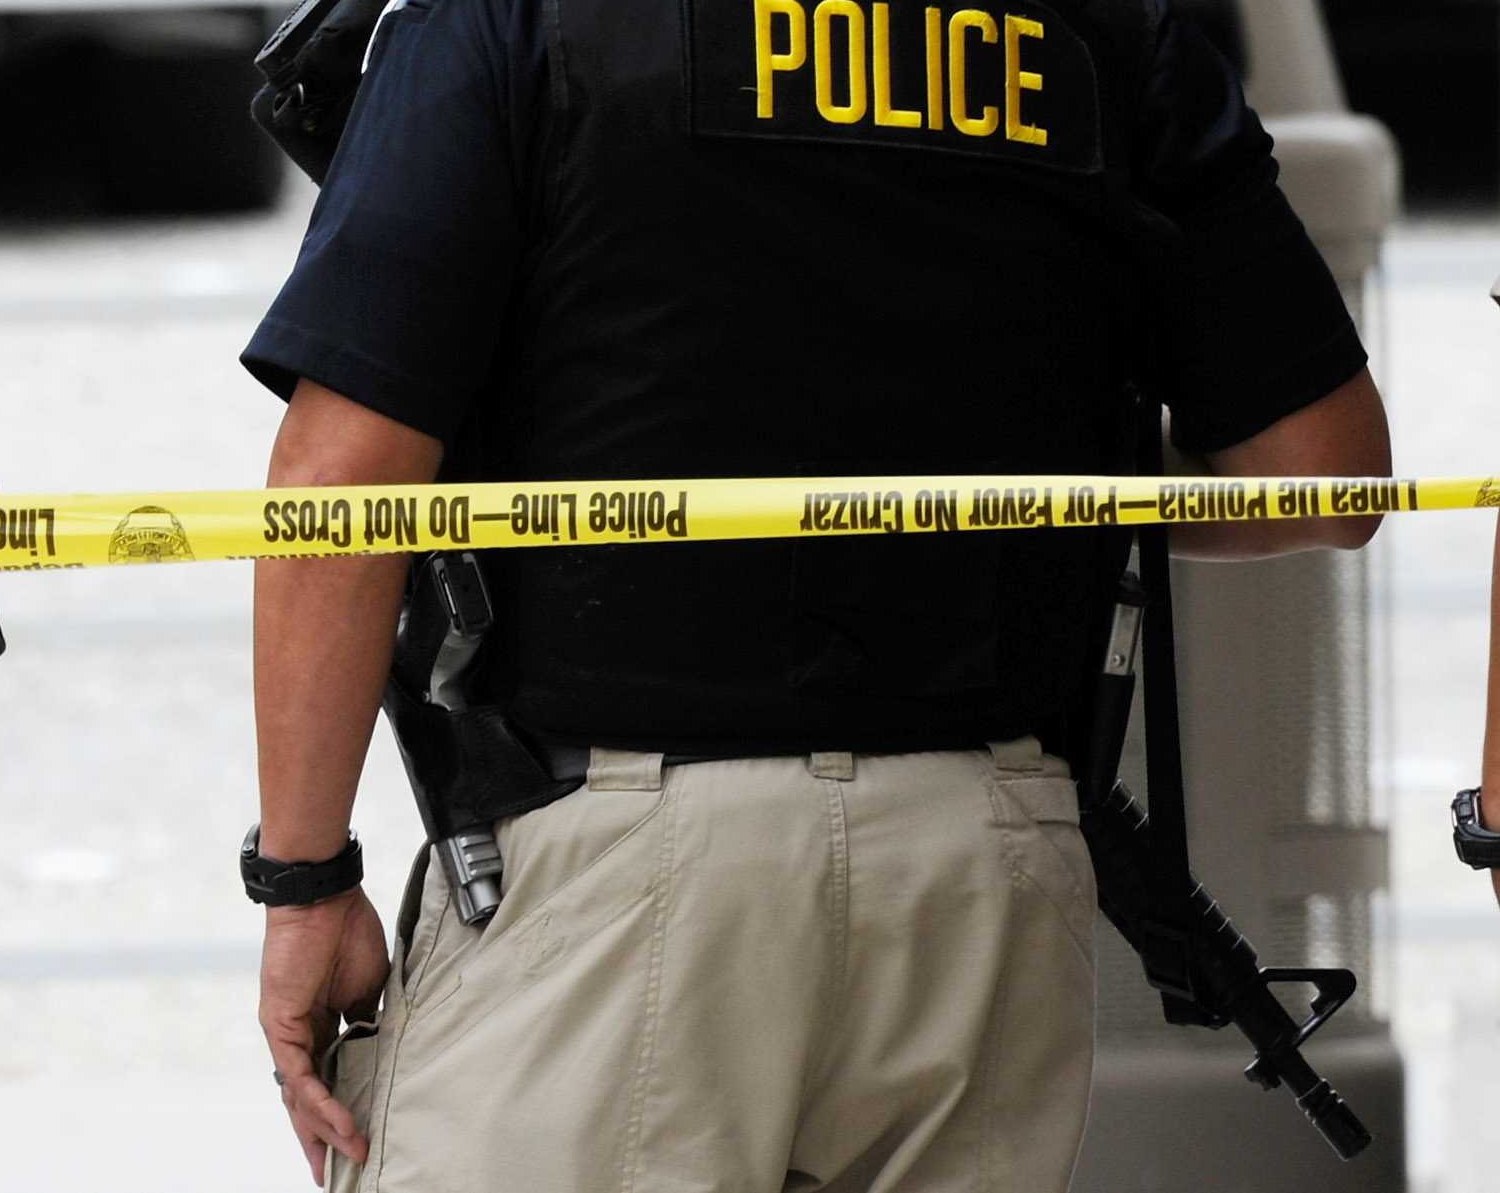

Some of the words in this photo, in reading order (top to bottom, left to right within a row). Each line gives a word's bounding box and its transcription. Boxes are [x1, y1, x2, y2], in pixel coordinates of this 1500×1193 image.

[589, 491, 688, 539] Police
[800, 490, 904, 533] Cruzar
[914, 489, 959, 531] No
[968, 487, 1053, 528] Favor
[1278, 479, 1321, 517] De
[1331, 479, 1418, 513] Linea
[264, 499, 351, 548] Cross
[363, 497, 418, 546] Not
